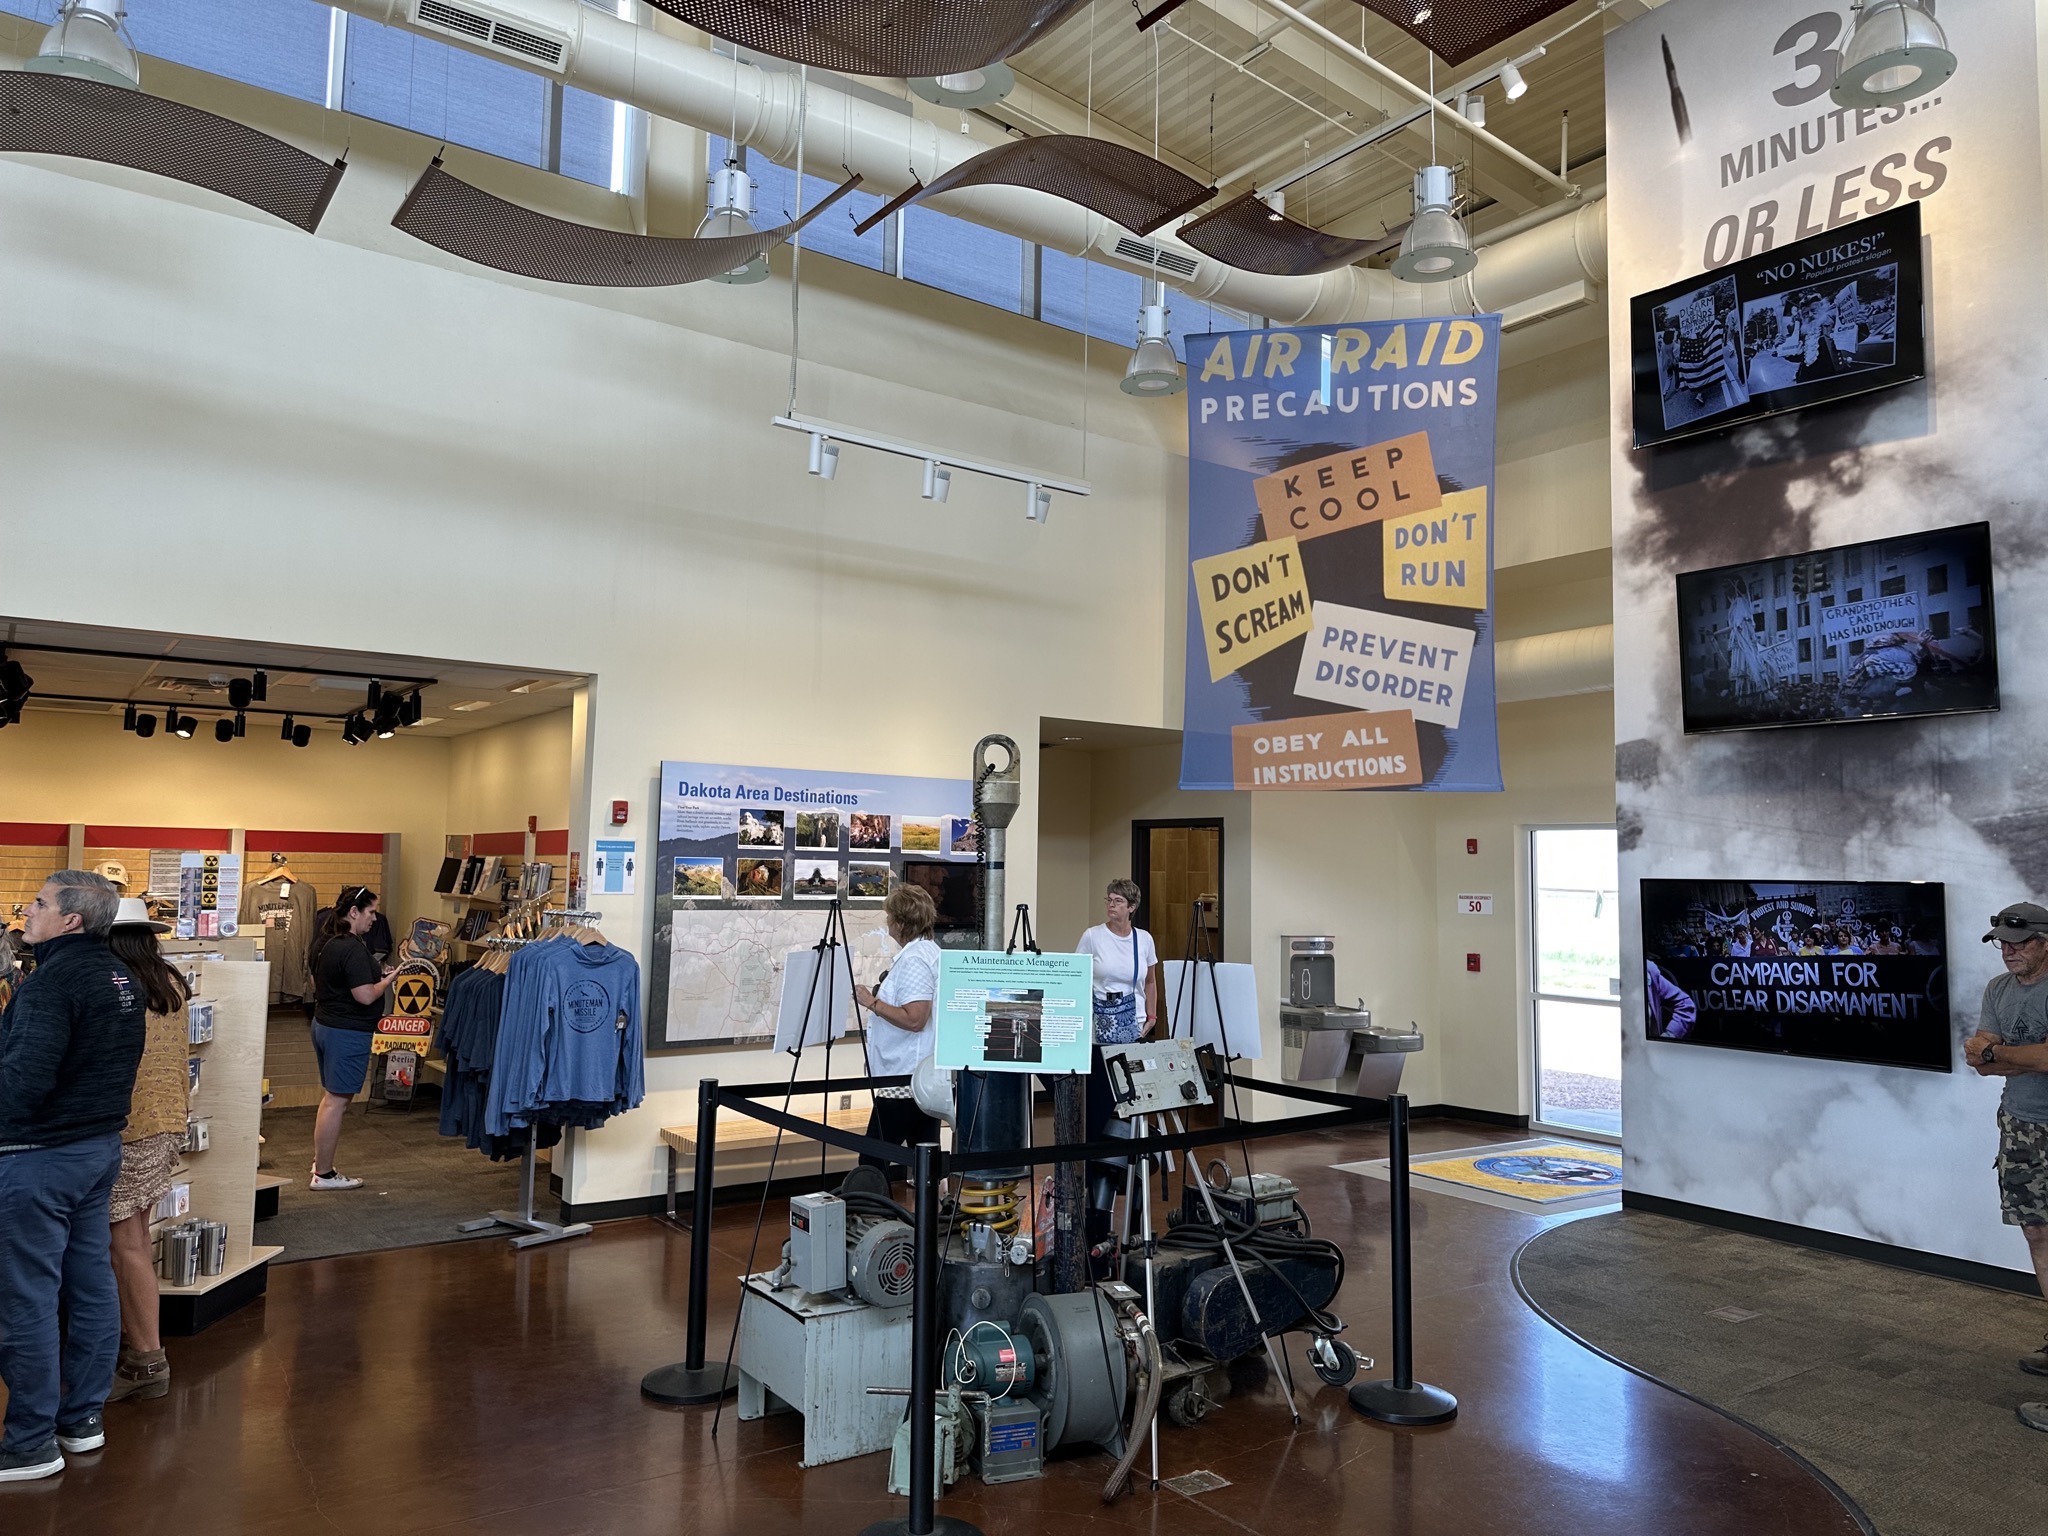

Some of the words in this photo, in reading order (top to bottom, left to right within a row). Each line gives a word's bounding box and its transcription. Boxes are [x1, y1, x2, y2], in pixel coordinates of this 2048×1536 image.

[1703, 199, 1779, 271] OR
[1795, 135, 1953, 241] LESS
[1805, 265, 1835, 280] Popular
[1835, 256, 1864, 271] protest
[1865, 248, 1892, 262] slogan
[1680, 297, 1714, 318] DISARM
[1200, 330, 1302, 383] AIR
[1331, 319, 1486, 375] RAID
[1201, 377, 1479, 424] PRECAUTIONS
[1284, 447, 1405, 499] KEEP
[1289, 479, 1411, 530] COOL
[1395, 512, 1478, 550] DON'T
[1211, 552, 1291, 603] DON'T
[1400, 559, 1466, 588] RUN
[1216, 589, 1306, 655] SCREAM
[1826, 596, 1915, 620] GRANDMOTHER
[1849, 610, 1884, 627] EARTH
[1829, 628, 1850, 642] HAS
[1852, 624, 1873, 637] HAD
[1874, 617, 1915, 633] ENOUGH
[1322, 625, 1459, 673] PREVENT
[1315, 659, 1454, 708] DISORDER
[1253, 731, 1325, 755] OBEY
[1341, 726, 1389, 748] ALL
[1253, 754, 1407, 785] INSTRUCTIONS
[679, 781, 731, 799] Dakota
[735, 784, 769, 801] Area
[774, 786, 858, 806] Destinations
[1469, 901, 1481, 912] 50
[1750, 901, 1775, 921] PROTEST
[1776, 900, 1789, 910] AND
[1790, 901, 1816, 918] SURVIVE
[962, 956, 969, 964] A
[971, 956, 1024, 966] Maintenance
[1026, 958, 1070, 968] Menagerie
[1711, 962, 1820, 986] CAMPAIGN
[1832, 962, 1880, 988] FOR
[574, 1007, 596, 1016] MISSILE
[1776, 990, 1923, 1020] DISARMAMENT
[383, 1019, 425, 1032] DANGER
[384, 1041, 416, 1050] RADIATION
[390, 1054, 415, 1063] Berlin
